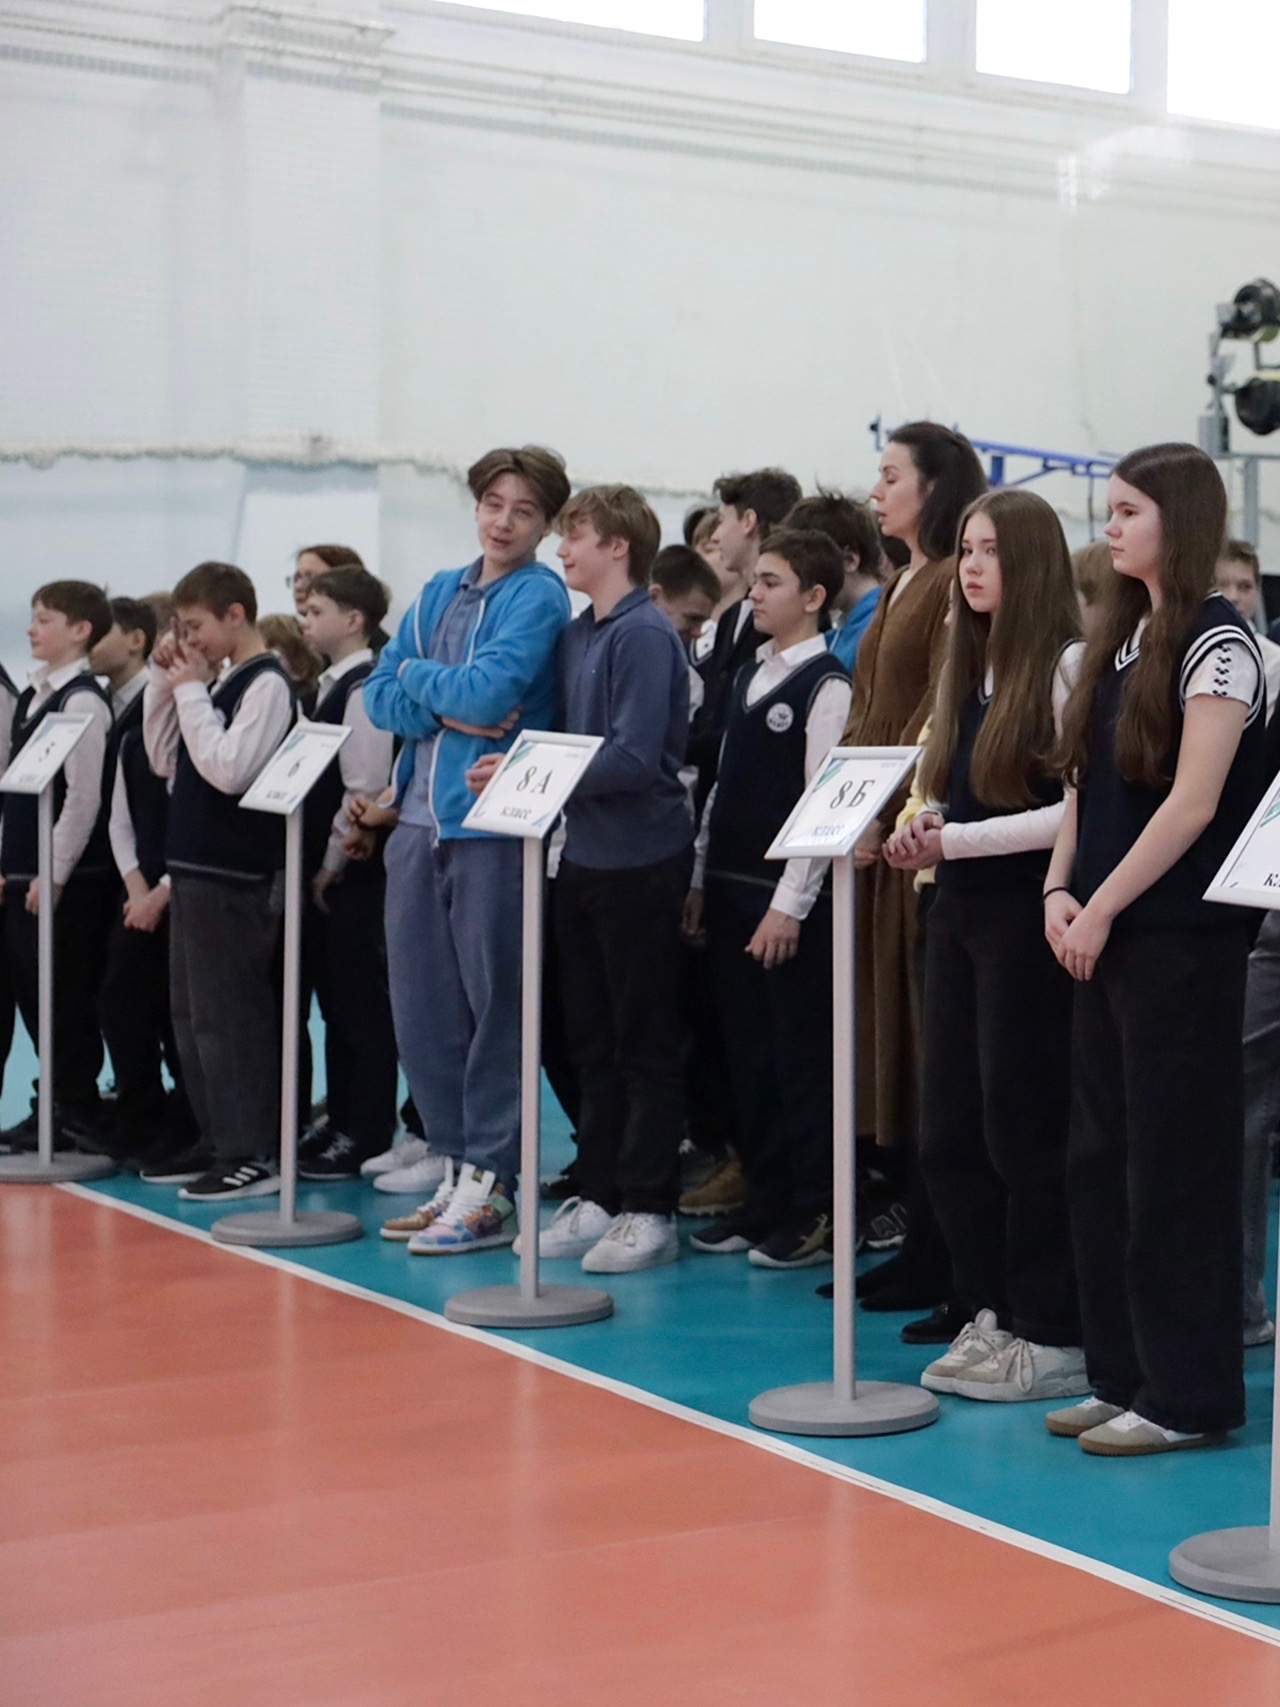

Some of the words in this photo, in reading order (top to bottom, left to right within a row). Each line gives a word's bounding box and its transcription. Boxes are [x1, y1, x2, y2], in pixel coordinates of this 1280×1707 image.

[516, 765, 537, 792] 8
[530, 769, 554, 794] А
[829, 780, 853, 809] 8
[845, 779, 876, 808] Б
